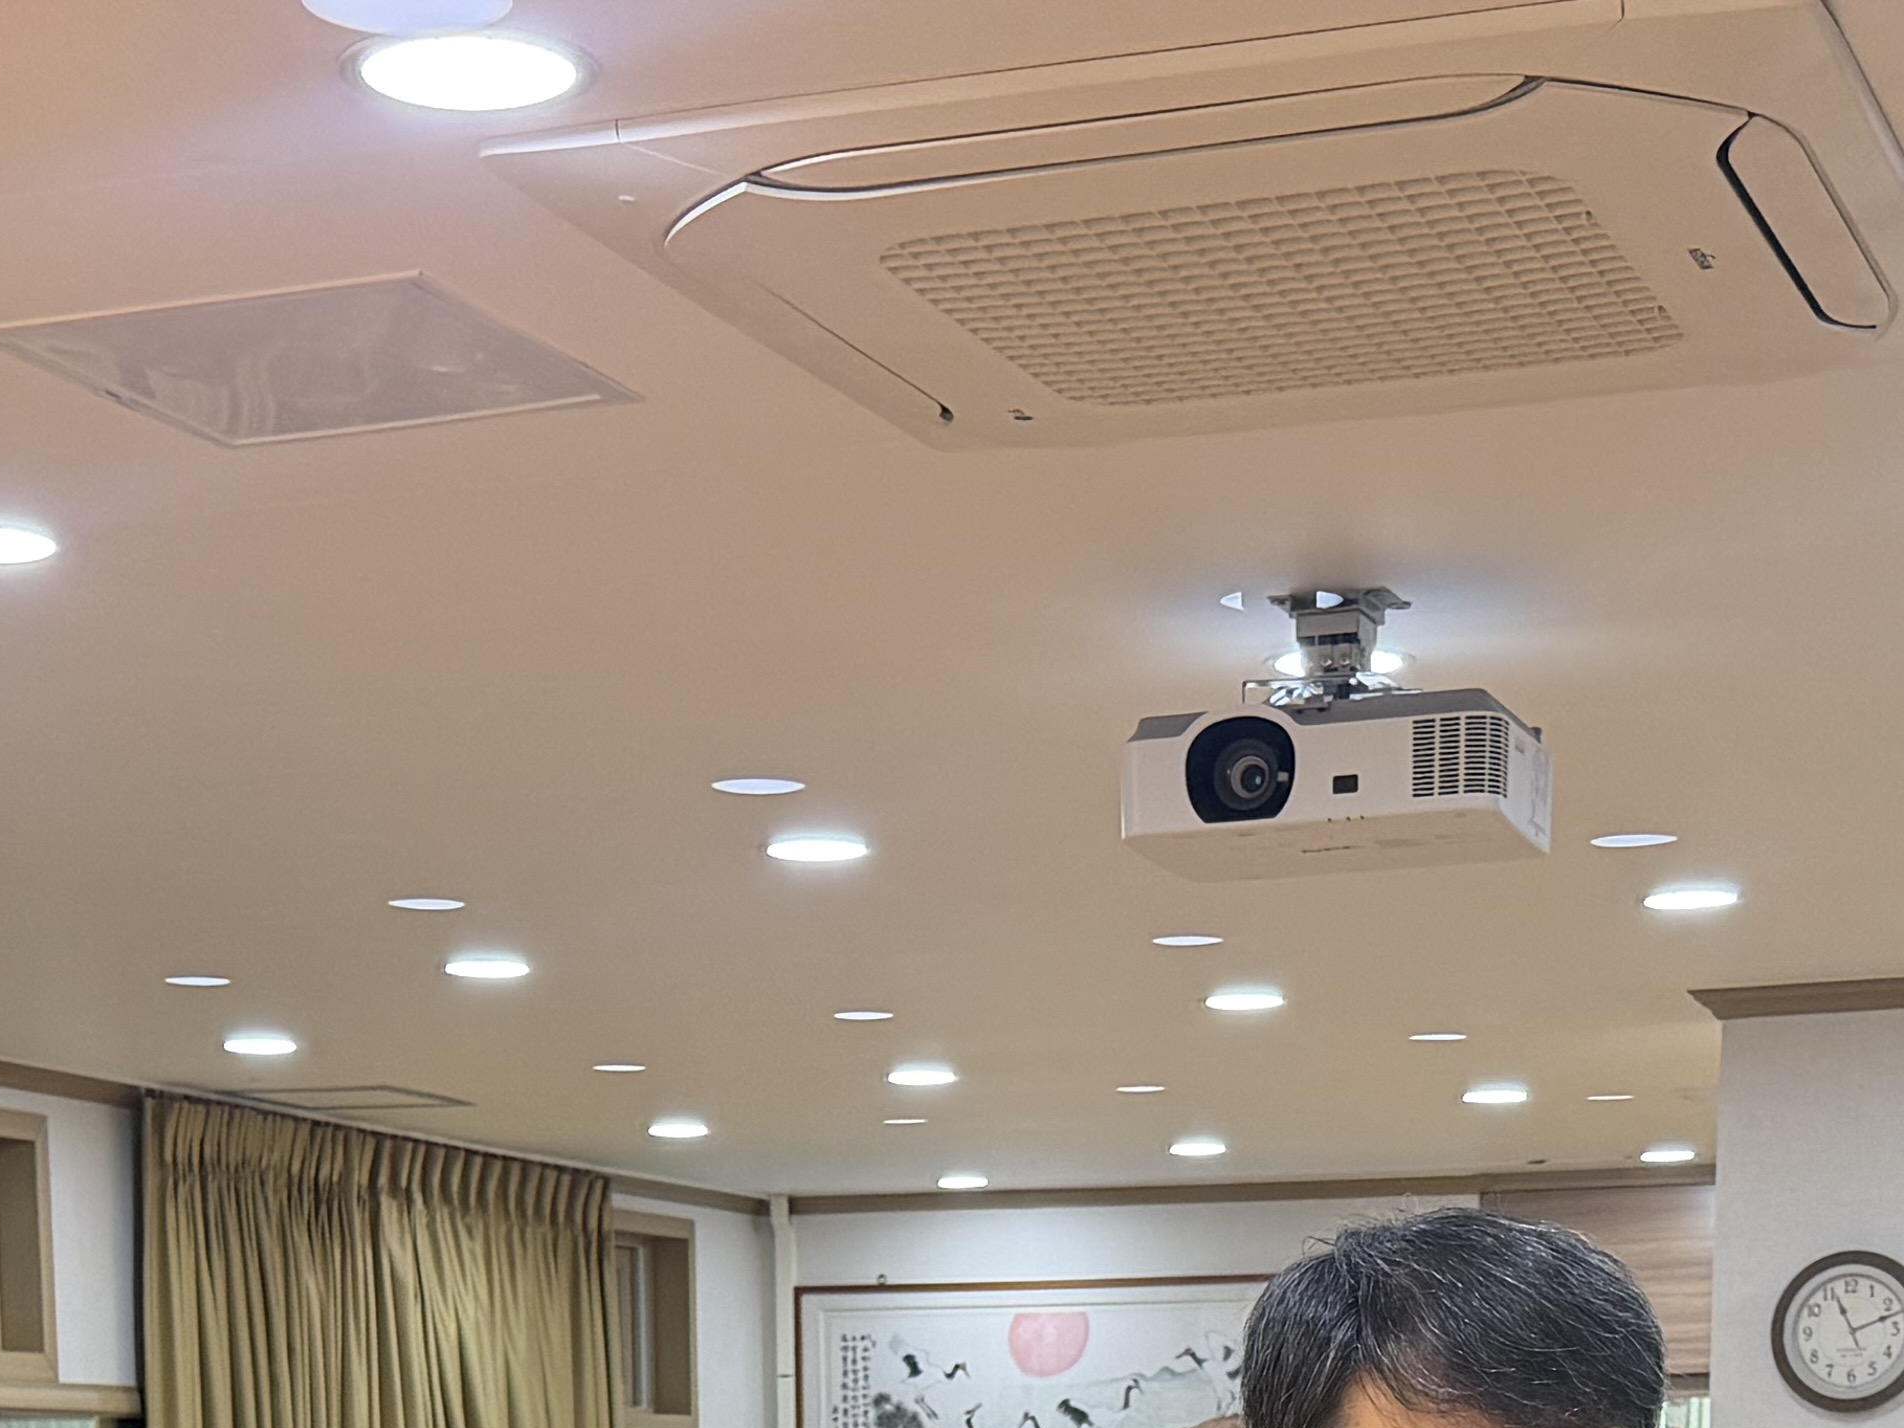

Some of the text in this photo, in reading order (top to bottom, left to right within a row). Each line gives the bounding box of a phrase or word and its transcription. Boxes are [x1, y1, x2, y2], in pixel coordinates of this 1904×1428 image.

[1844, 1279, 1859, 1293] 12
[1869, 1284, 1876, 1298] 1
[1823, 1287, 1836, 1301] 11
[1807, 1304, 1822, 1318] 10
[1883, 1298, 1893, 1312] 2
[1802, 1326, 1813, 1341] 9
[1891, 1322, 1901, 1336] 3
[1809, 1350, 1819, 1364] 8
[1883, 1345, 1893, 1359] 4
[1825, 1364, 1835, 1378] 7
[1847, 1369, 1856, 1383] 6
[1868, 1362, 1878, 1376] 5
